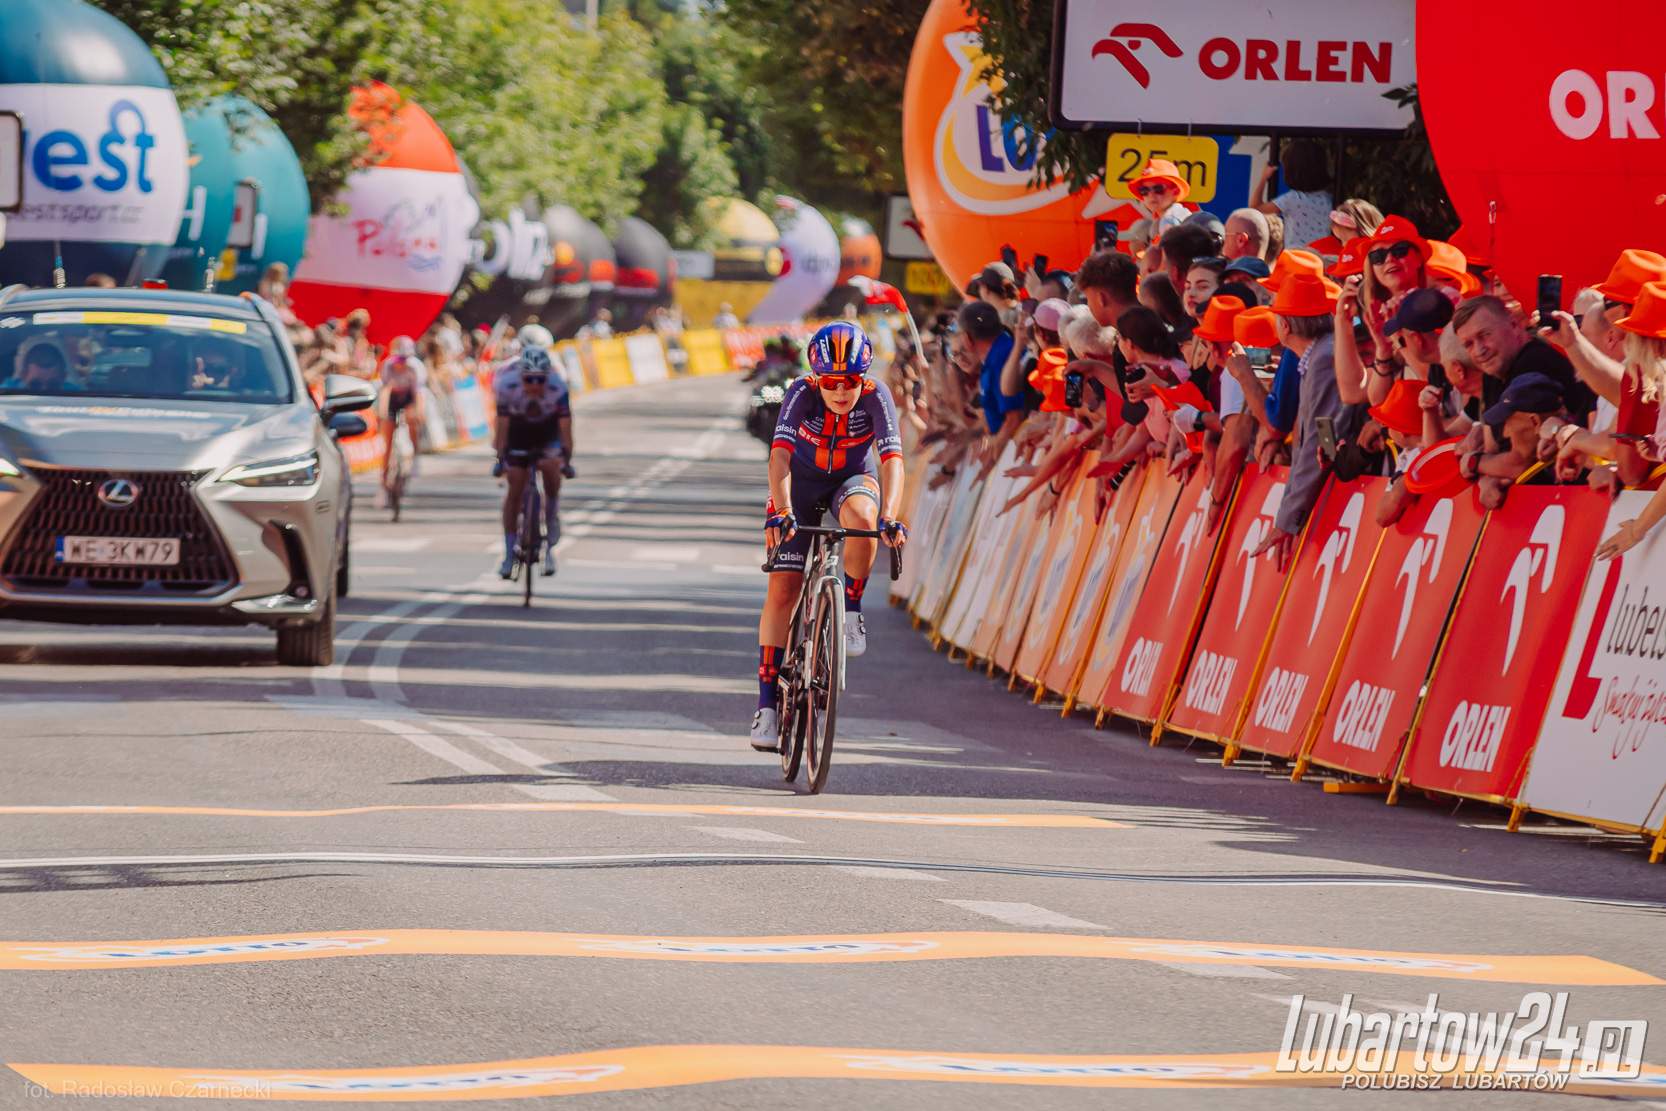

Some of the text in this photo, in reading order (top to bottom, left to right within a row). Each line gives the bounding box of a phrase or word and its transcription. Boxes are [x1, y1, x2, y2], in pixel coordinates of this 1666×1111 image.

[1198, 37, 1392, 83] ORLEN
[1549, 69, 1666, 140] OR
[22, 99, 155, 194] est
[71, 540, 173, 562] WE 3KW79
[1185, 649, 1238, 716] ORLEN
[1254, 666, 1309, 734] ORLEN
[1332, 679, 1396, 752] ORLEN
[1439, 700, 1511, 773] ORLEN
